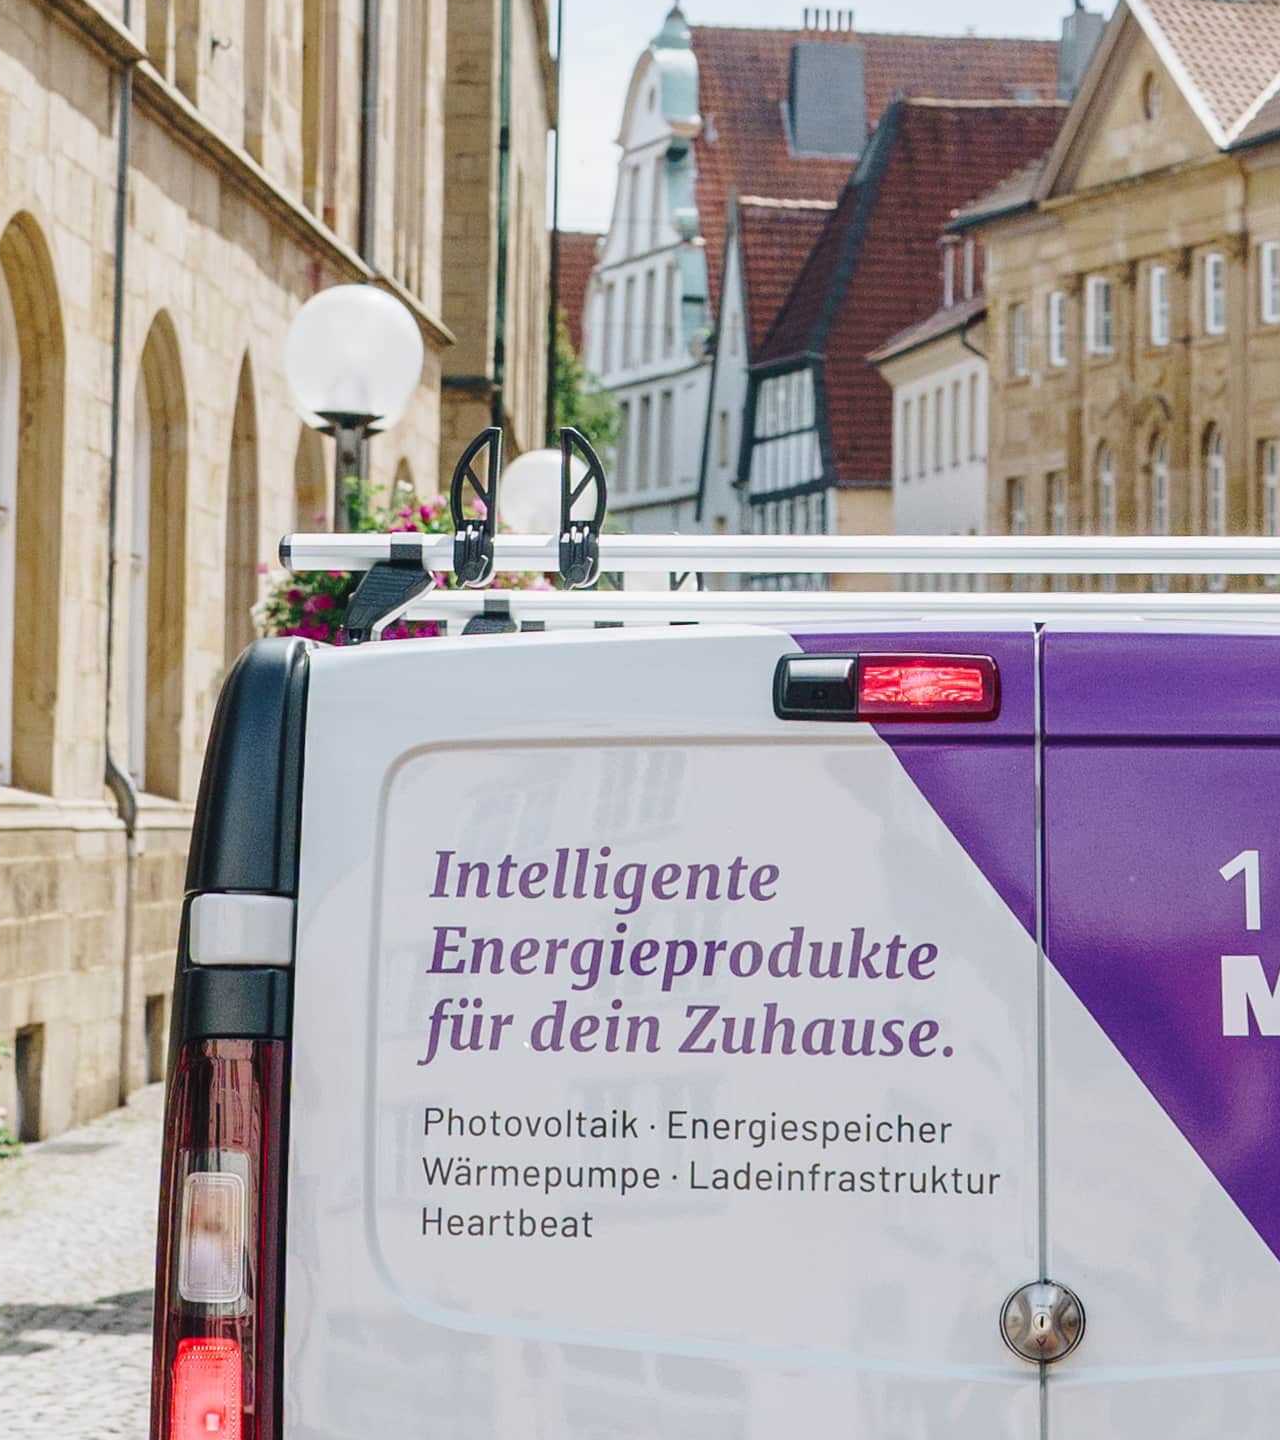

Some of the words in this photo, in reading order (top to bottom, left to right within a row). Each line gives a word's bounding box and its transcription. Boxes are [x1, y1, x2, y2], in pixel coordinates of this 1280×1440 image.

[429, 847, 780, 915] Intelligente
[426, 923, 939, 992] Energieprodukte
[417, 998, 513, 1066] für
[531, 1000, 661, 1053] dein
[679, 1005, 955, 1058] Zuhause.
[424, 1108, 638, 1139] Photovoltaik
[668, 1111, 952, 1149] Energiespeicher
[423, 1157, 660, 1196] Wärmepumpe
[690, 1161, 1001, 1195] Ladeinfrastruktur
[422, 1207, 593, 1238] Heartbeat
